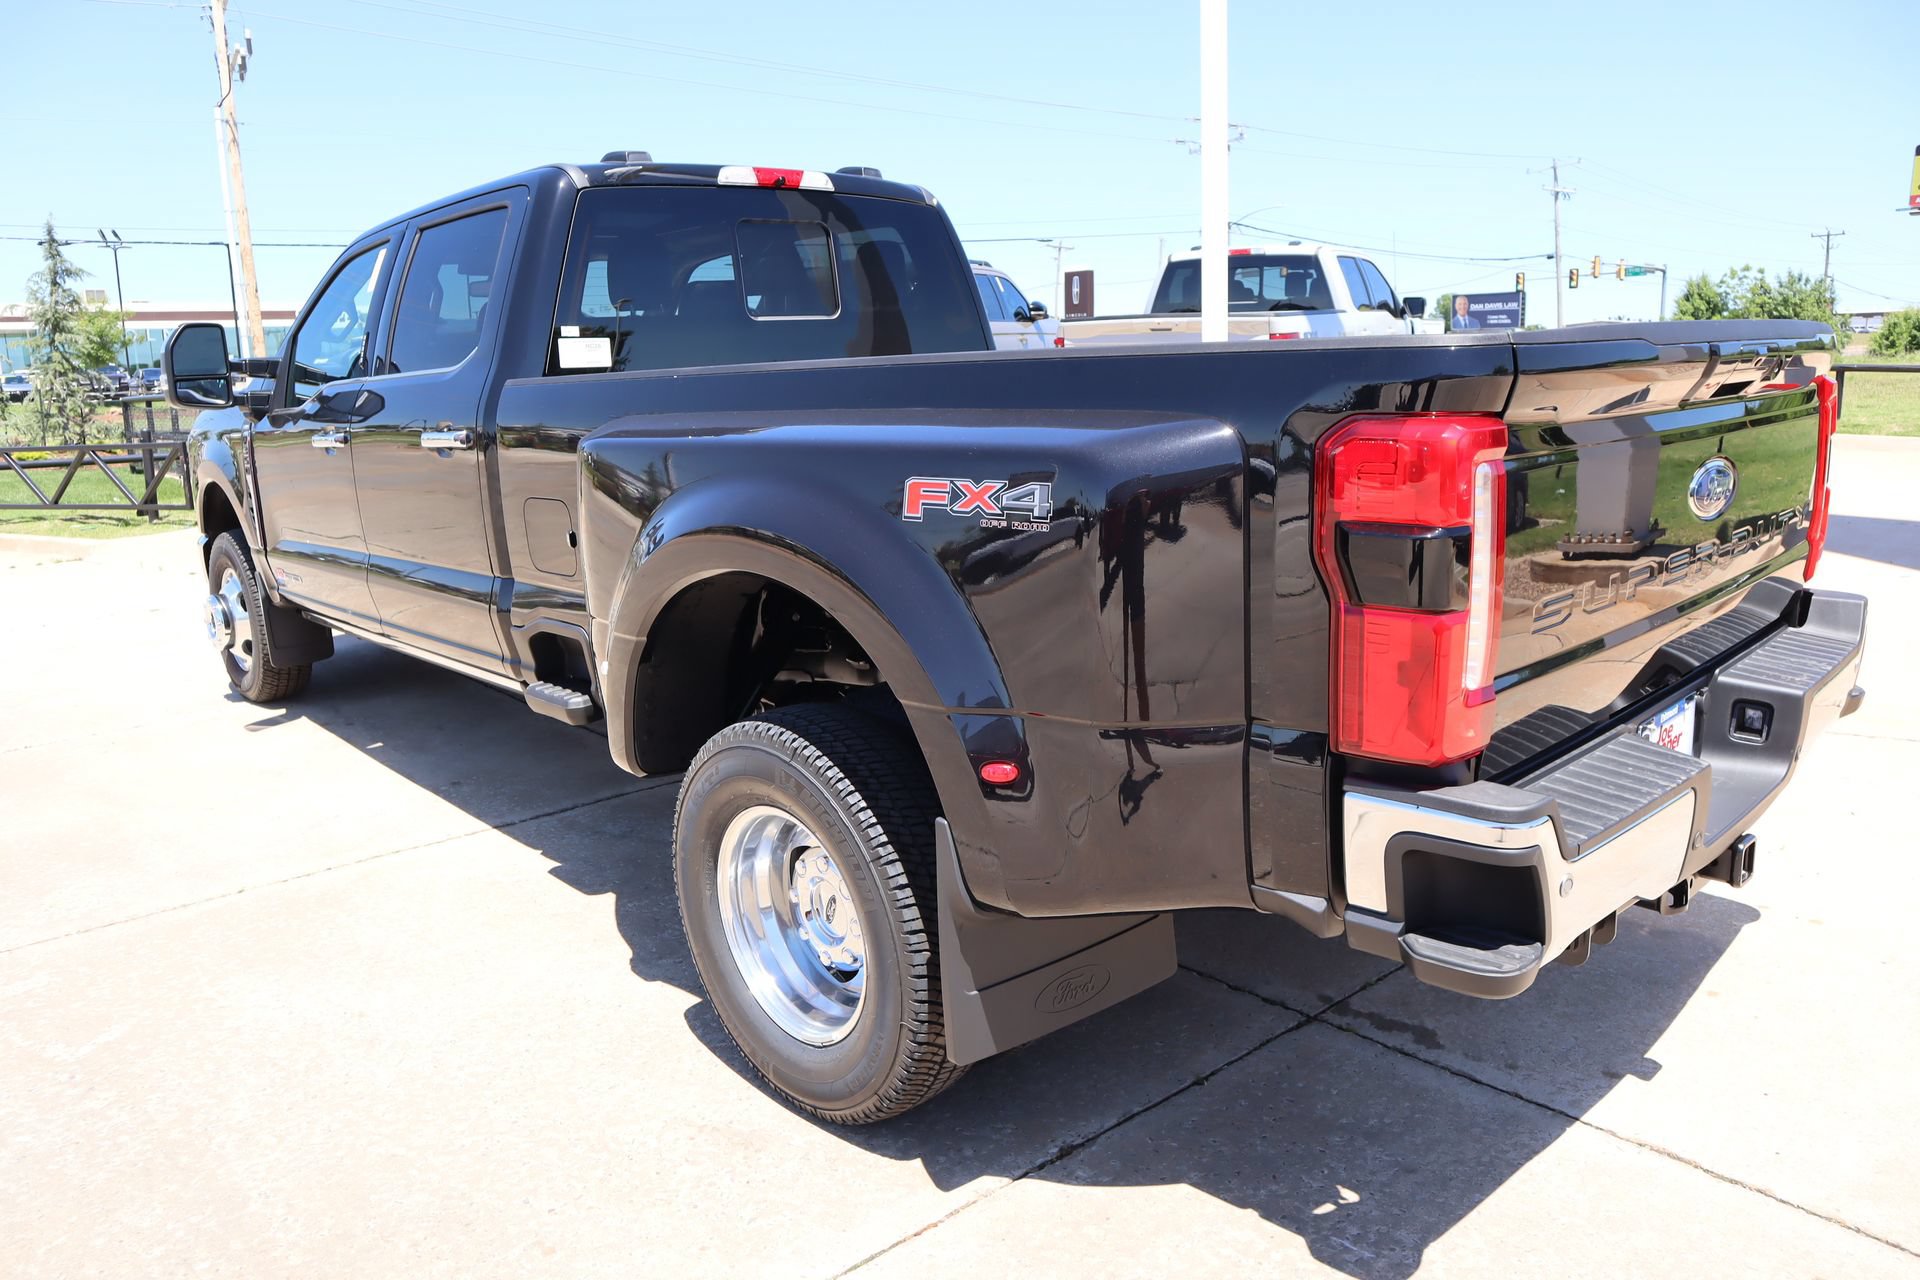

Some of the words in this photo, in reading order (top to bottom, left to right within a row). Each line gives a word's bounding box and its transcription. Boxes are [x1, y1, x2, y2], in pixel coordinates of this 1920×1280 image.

[902, 476, 1054, 523] FX4
[980, 518, 1007, 529] OFF
[1012, 521, 1050, 532] ROAD
[1656, 724, 1674, 745] Joe
[1053, 973, 1094, 1009] Ford
